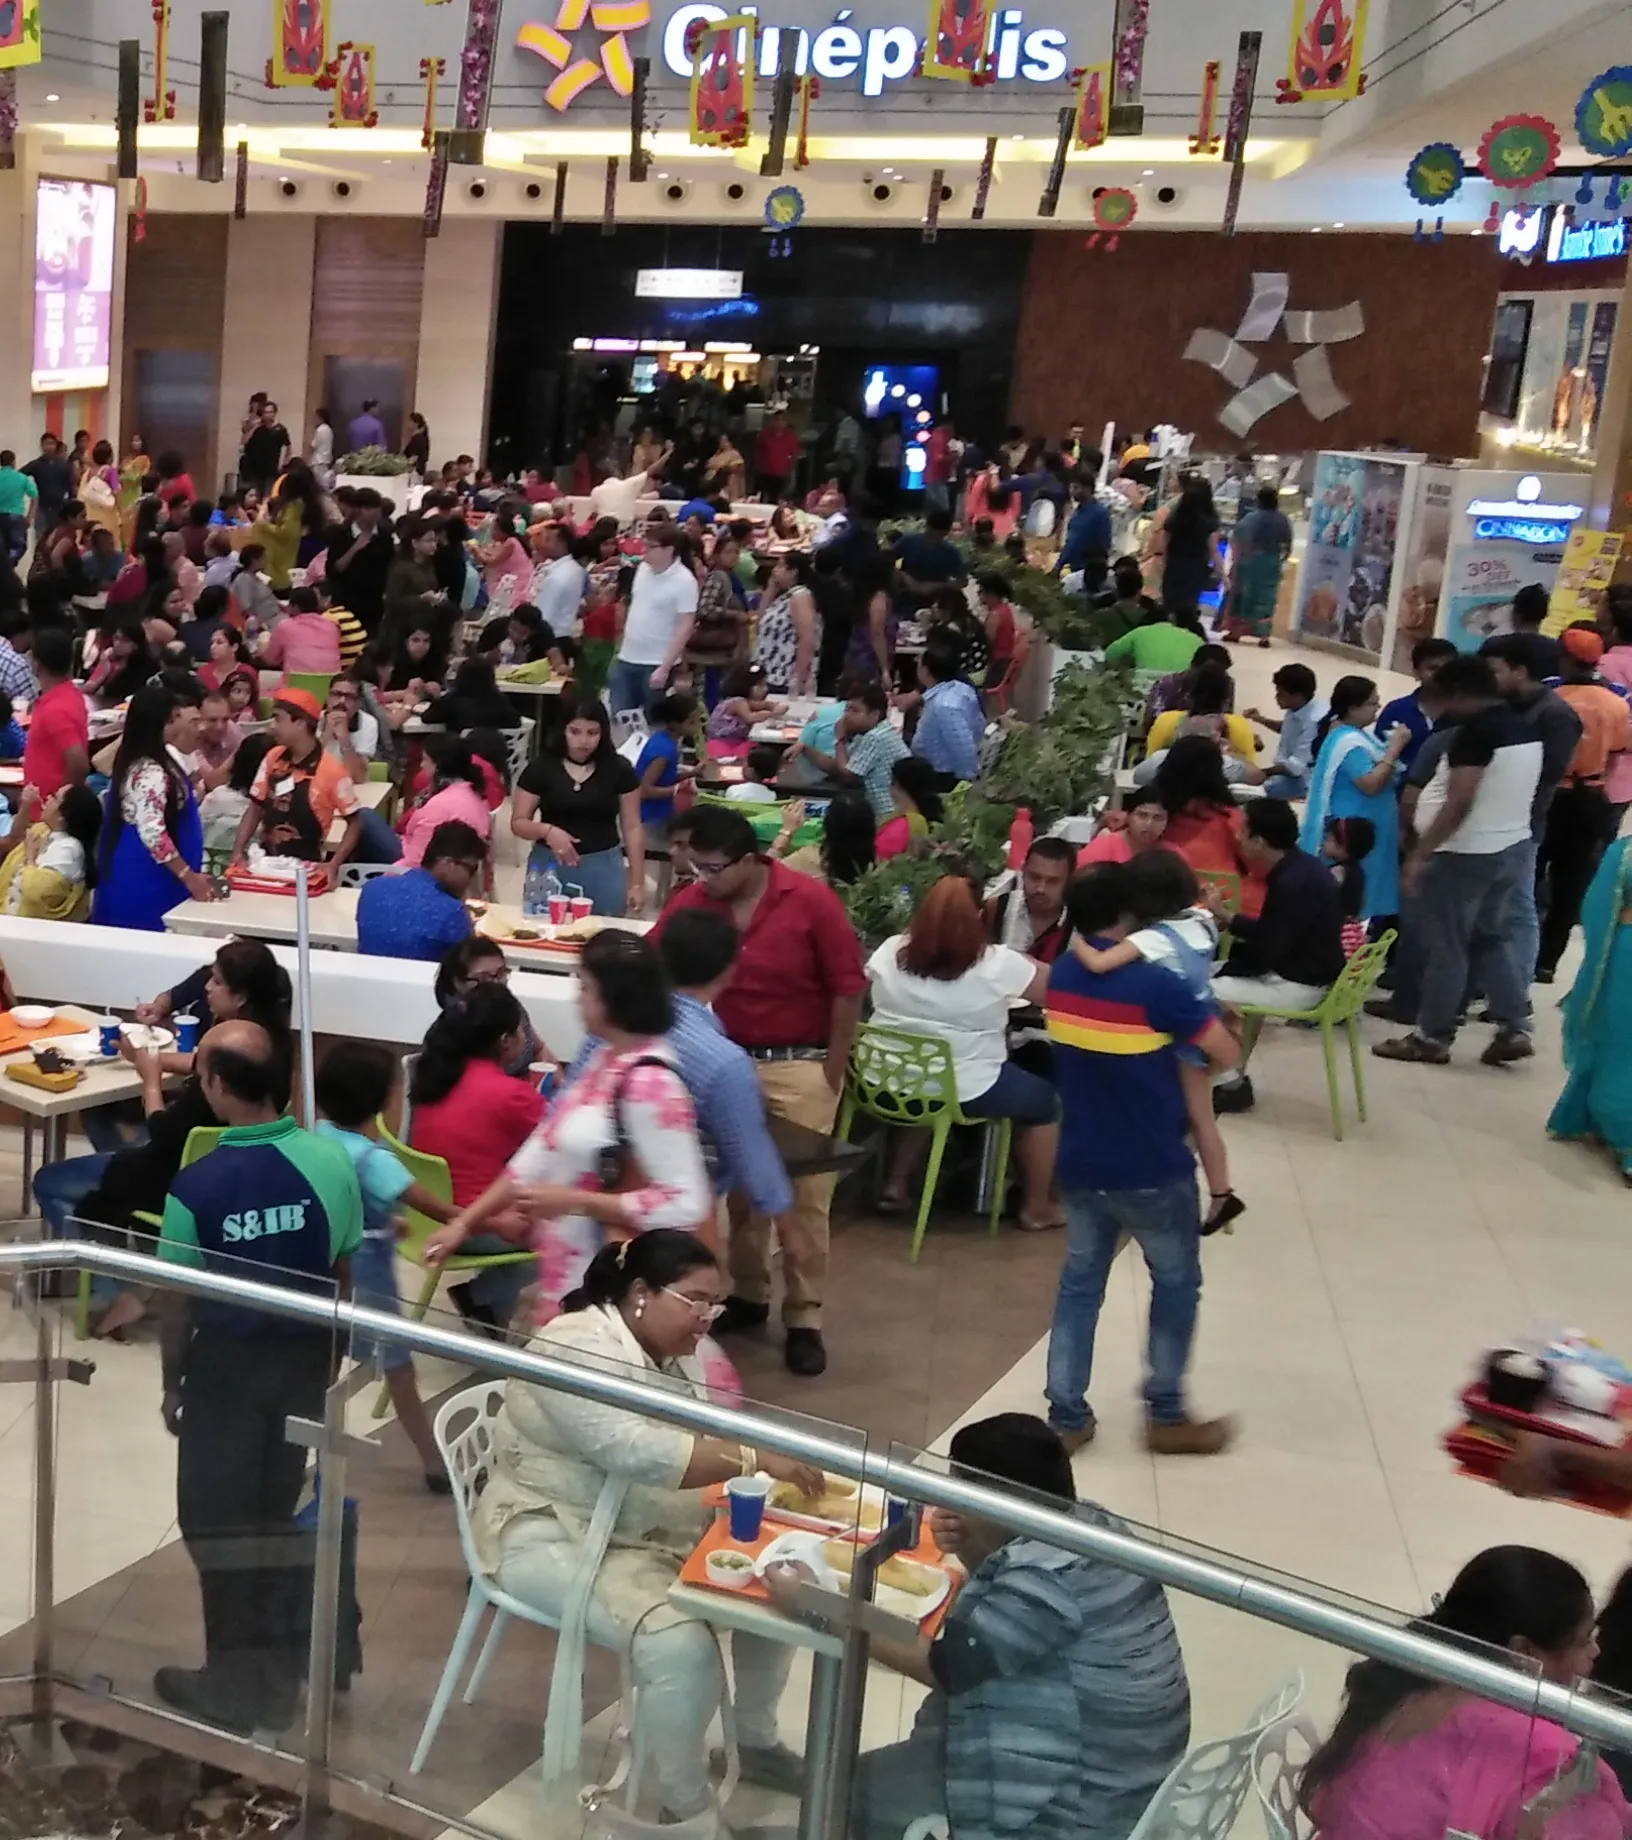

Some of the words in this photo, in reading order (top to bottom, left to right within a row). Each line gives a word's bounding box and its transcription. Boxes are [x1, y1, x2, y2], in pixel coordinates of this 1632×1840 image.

[664, 3, 1067, 96] Cinéplis
[1467, 559, 1507, 577] 30%
[222, 1203, 306, 1242] S&IB
